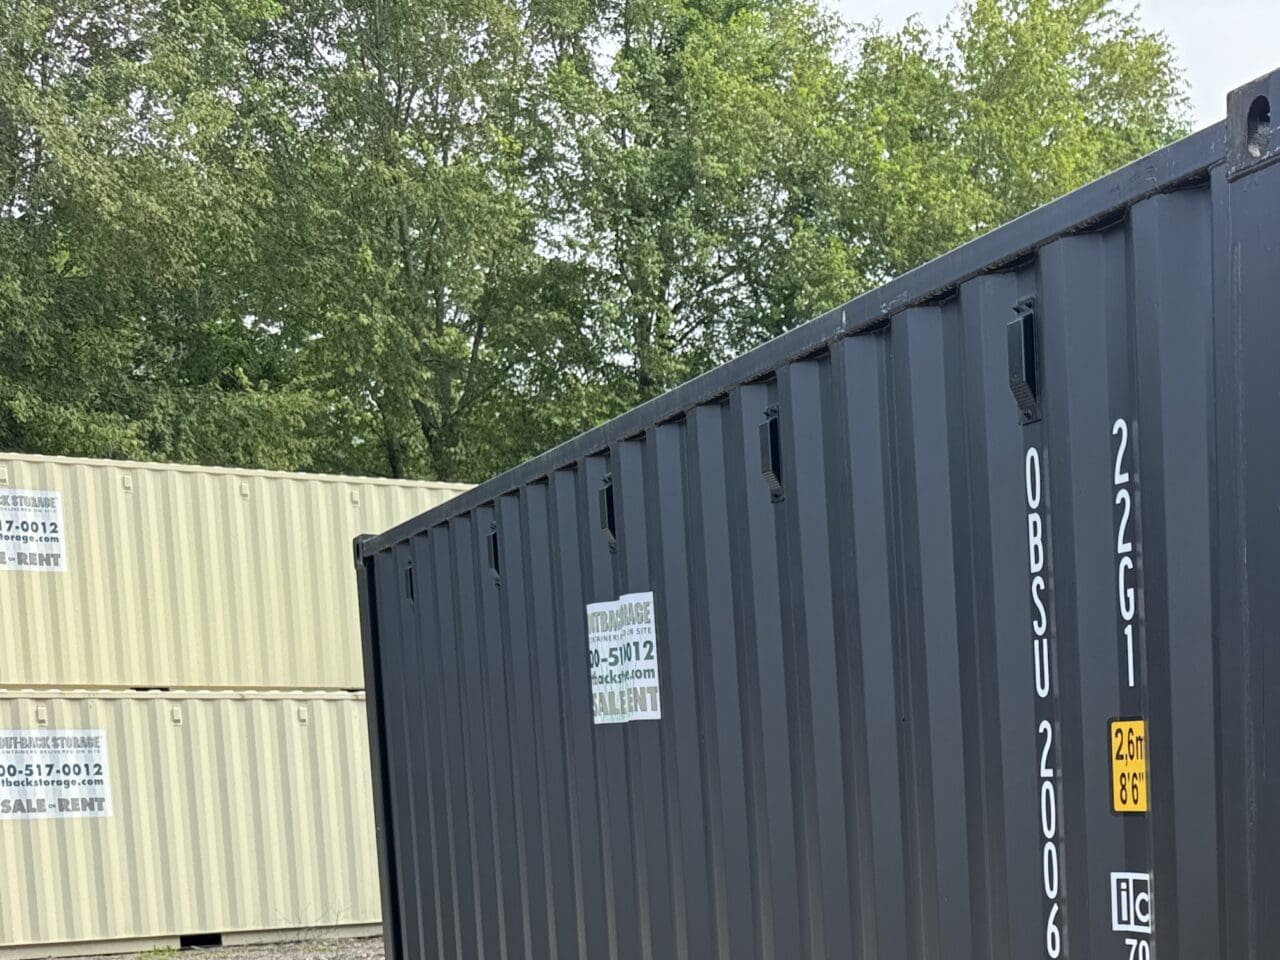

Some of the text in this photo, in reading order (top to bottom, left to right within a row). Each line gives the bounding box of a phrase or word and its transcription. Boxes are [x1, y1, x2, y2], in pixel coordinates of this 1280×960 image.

[16, 552, 61, 566] RENT
[1025, 447, 1050, 698] OBSU
[1112, 418, 1136, 687] 22G1
[0, 798, 47, 813] SALE
[58, 797, 105, 812] RENT
